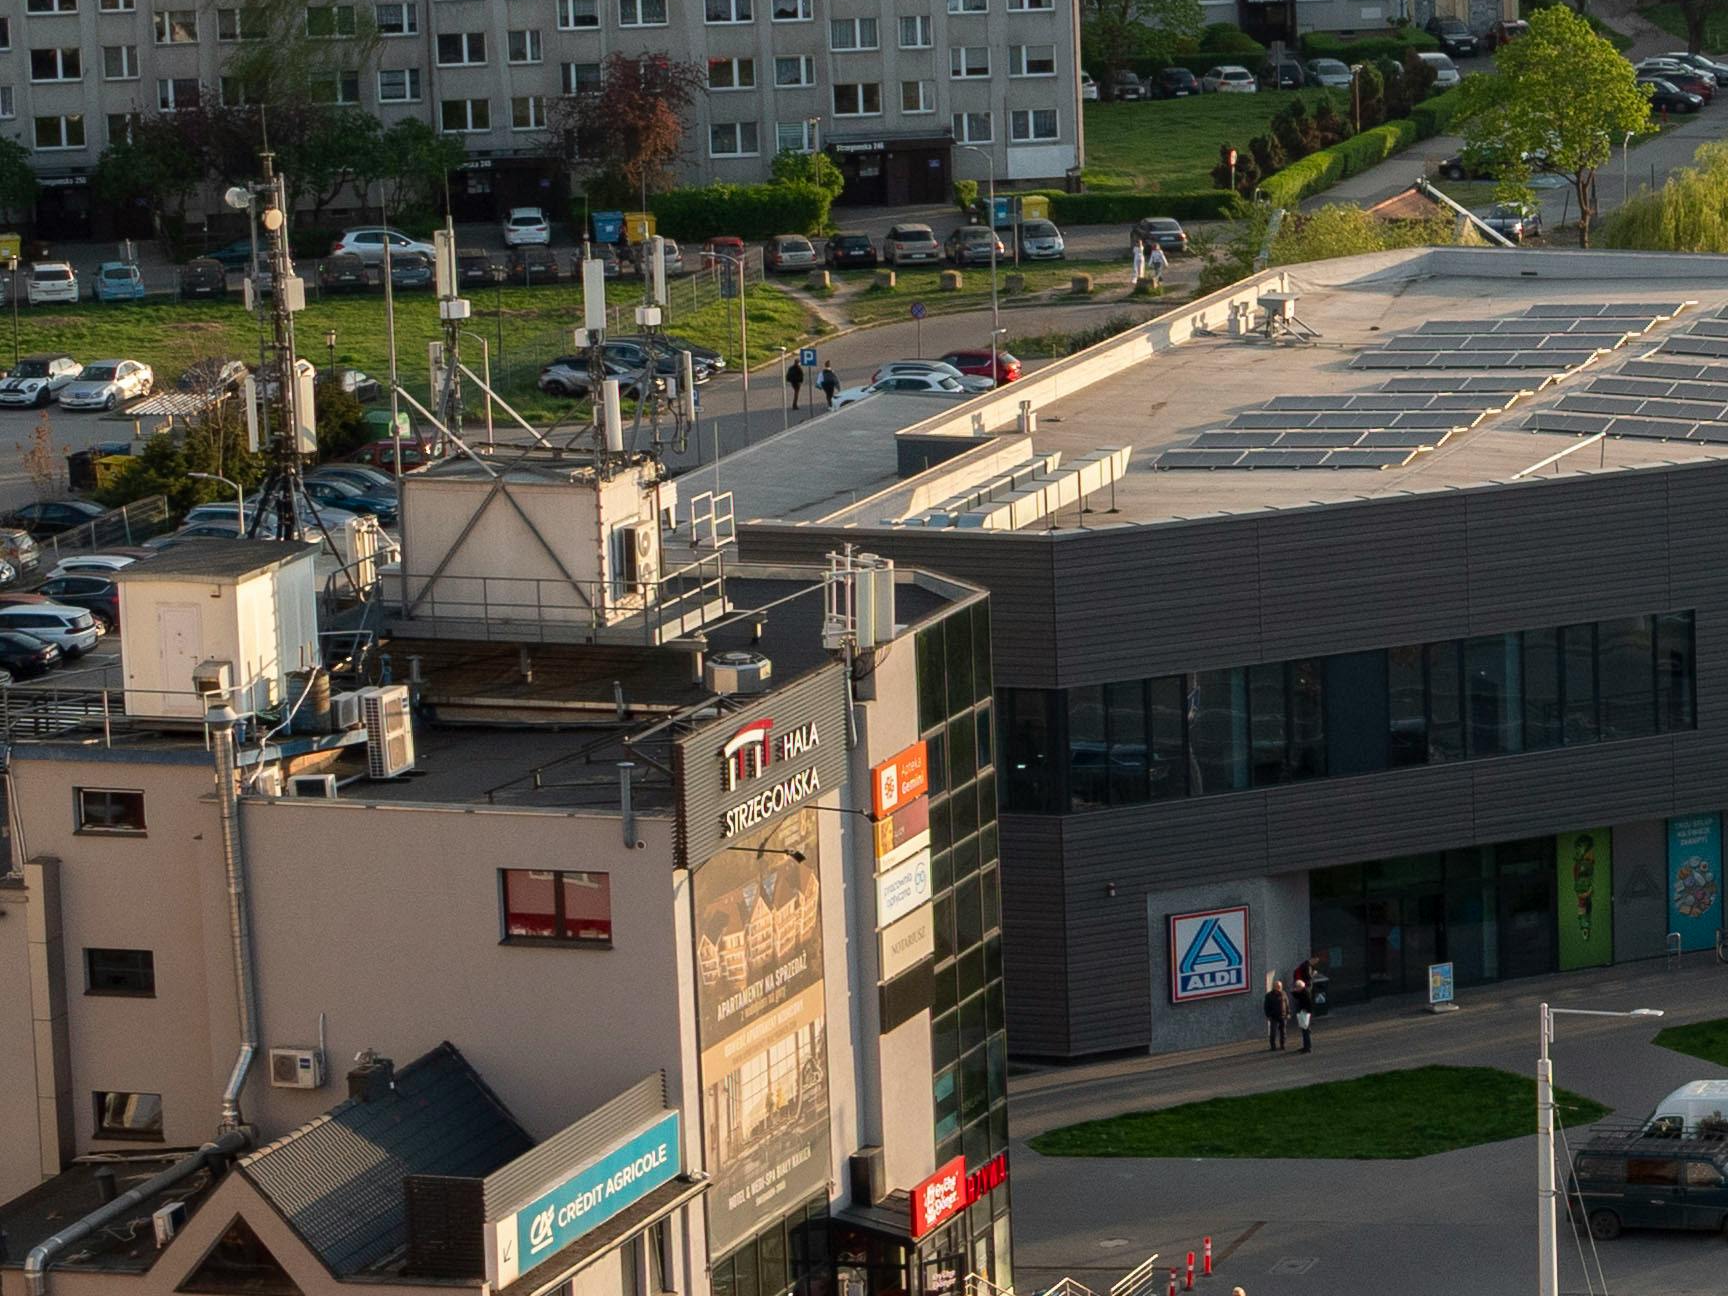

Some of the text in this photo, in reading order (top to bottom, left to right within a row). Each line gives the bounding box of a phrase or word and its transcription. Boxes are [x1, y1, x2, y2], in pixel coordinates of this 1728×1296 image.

[783, 721, 820, 761] HALA
[901, 772, 925, 794] Gemini
[725, 766, 821, 839] STRZEGOMSKA
[891, 926, 926, 954] NOTARIUSZ
[1187, 969, 1237, 990] ALDI
[558, 1183, 604, 1228] CRÉDIT
[605, 1143, 668, 1199] AGRICOLE
